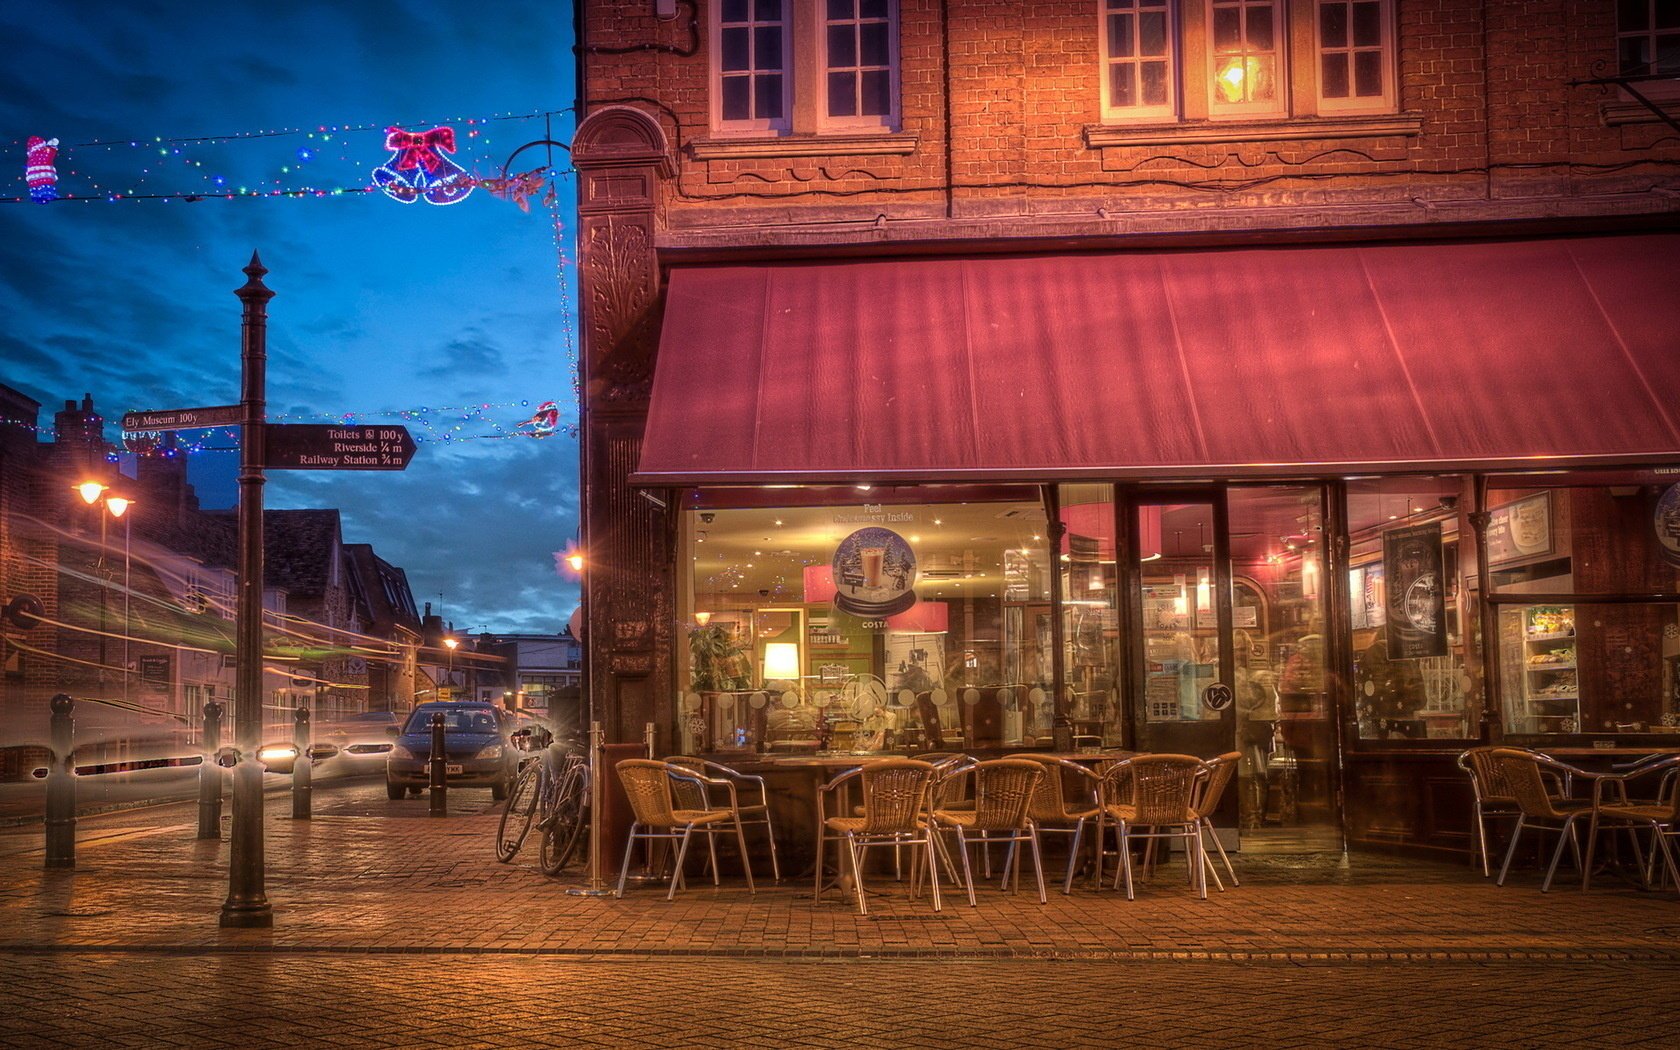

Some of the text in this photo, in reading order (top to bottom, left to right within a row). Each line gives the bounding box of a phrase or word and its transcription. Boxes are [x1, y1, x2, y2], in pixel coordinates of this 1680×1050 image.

[125, 417, 139, 428] Ely
[143, 416, 175, 426] Museum
[327, 429, 360, 440] Toilets
[334, 443, 378, 452] Riverside
[300, 455, 339, 467] Railway
[343, 455, 378, 465] Station
[863, 503, 882, 513] Feel
[887, 511, 914, 522] Inside
[861, 621, 889, 629] COSTA
